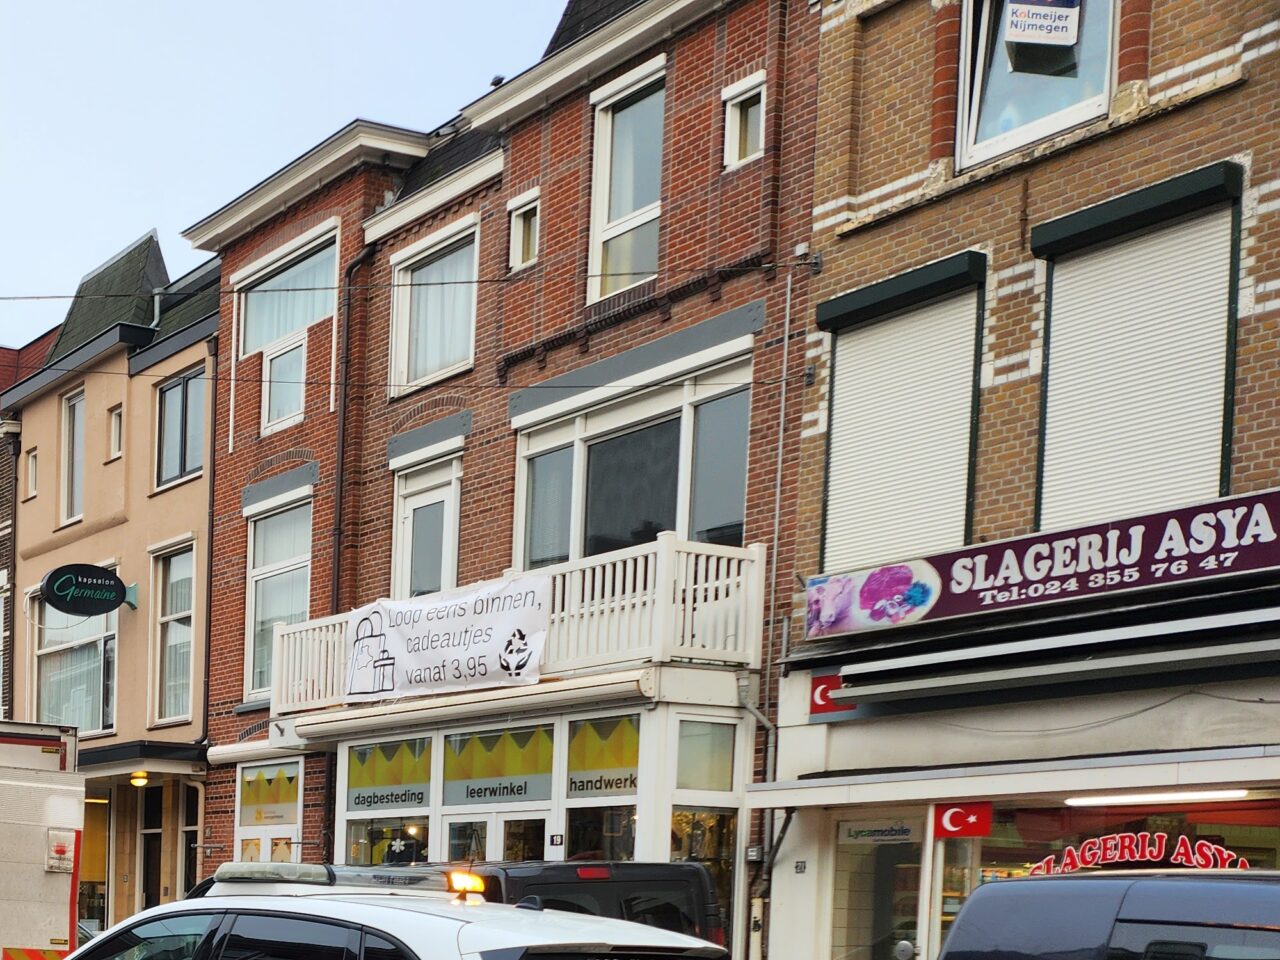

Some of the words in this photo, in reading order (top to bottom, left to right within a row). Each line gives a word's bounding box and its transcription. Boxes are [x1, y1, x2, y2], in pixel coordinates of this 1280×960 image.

[1011, 9, 1070, 23] Kolmeijer
[1010, 20, 1068, 34] Nijmegen
[950, 525, 1146, 594] SLAGERIJ
[1154, 502, 1278, 559] ASYA
[53, 574, 117, 601] Germaine
[78, 576, 115, 585] kapsalon
[978, 578, 1080, 606] Tel:024
[1087, 567, 1141, 589] 355
[1150, 559, 1189, 578] 76
[1198, 551, 1240, 571] 47
[388, 608, 421, 629] Loop
[426, 601, 468, 621] eens
[473, 590, 542, 616] binnen,
[406, 625, 494, 654] cadeautjes
[405, 660, 447, 685] vanaf
[451, 655, 488, 682] 3,95
[466, 781, 528, 799] leerwinkel
[569, 773, 638, 792] handwerk
[354, 790, 424, 808] dagbesteding
[847, 826, 911, 839] Lycamobile
